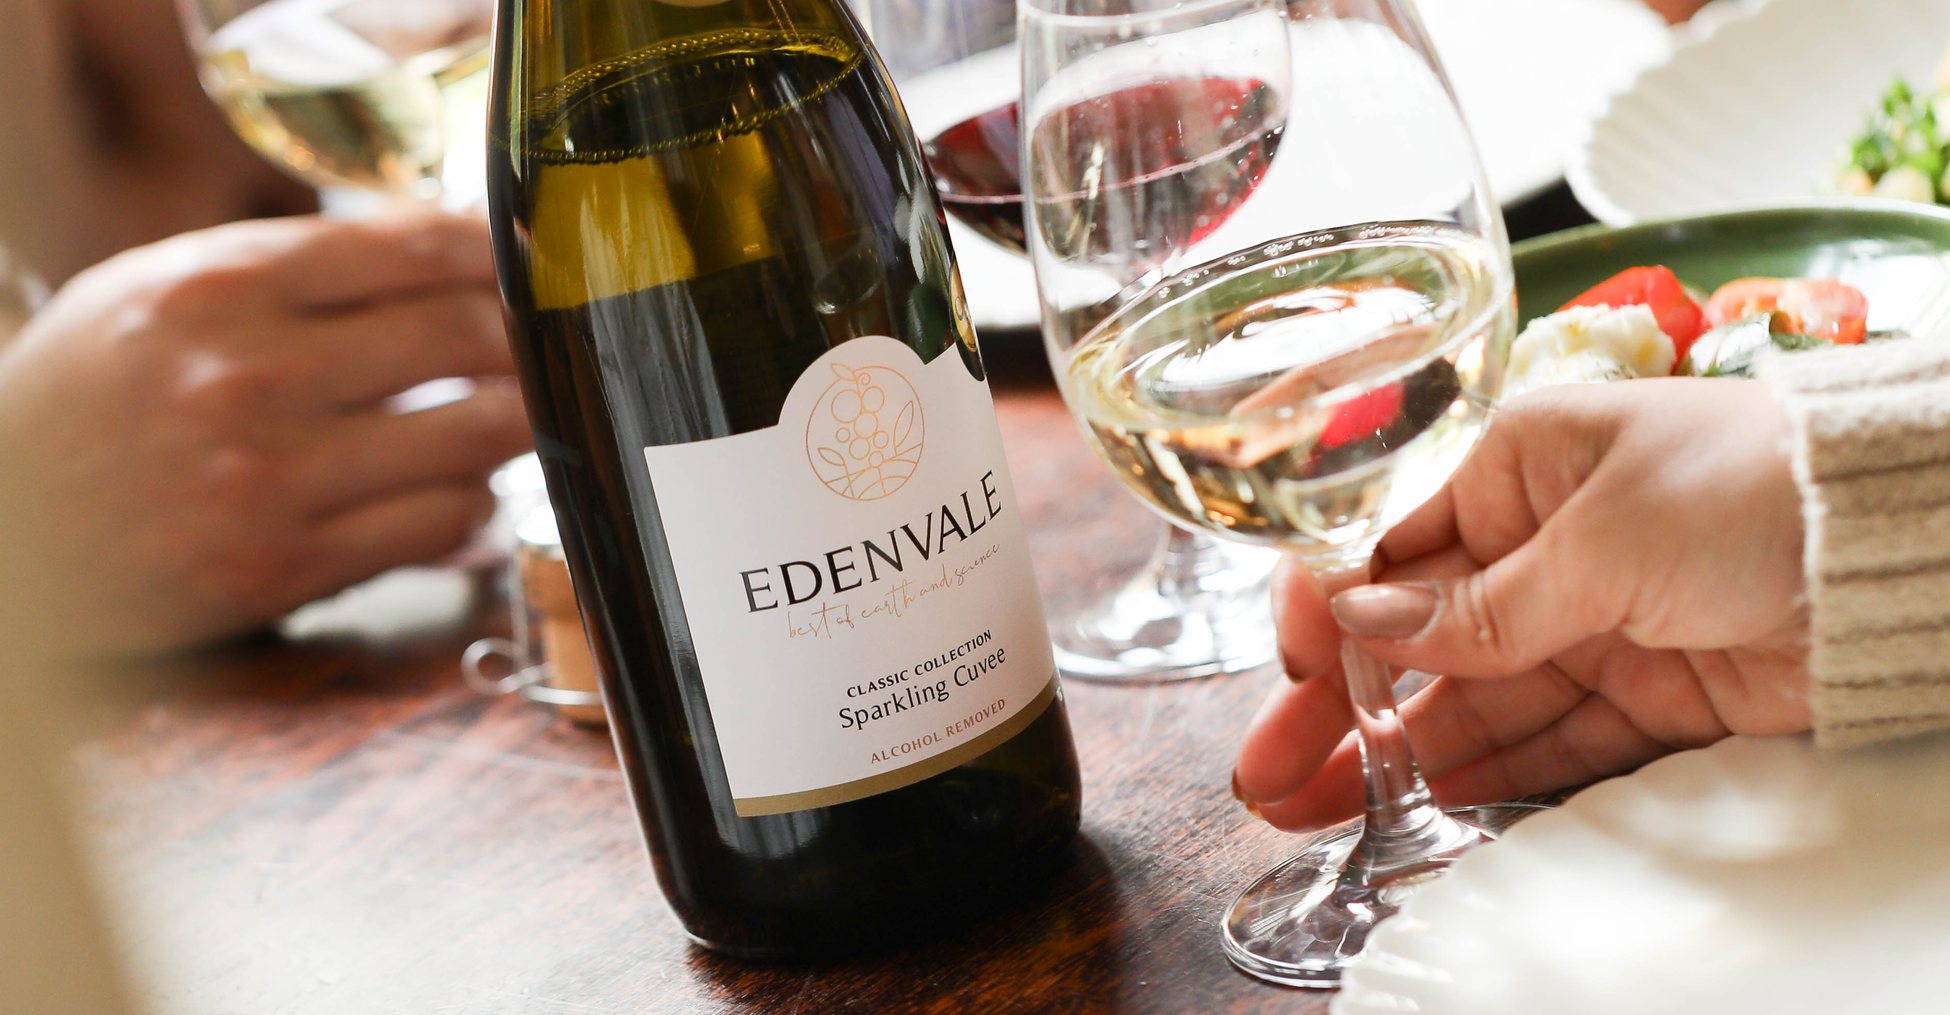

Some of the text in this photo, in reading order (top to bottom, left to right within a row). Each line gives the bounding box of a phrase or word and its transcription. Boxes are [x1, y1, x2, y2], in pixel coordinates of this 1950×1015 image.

[738, 469, 1002, 614] EDENVALE
[787, 543, 1001, 639] best of earth and science
[838, 647, 1007, 731] Sparkling Cuvee
[846, 629, 992, 698] CLASSIC COLLECTION
[871, 698, 1006, 764] ALCOHOL REMOVED
